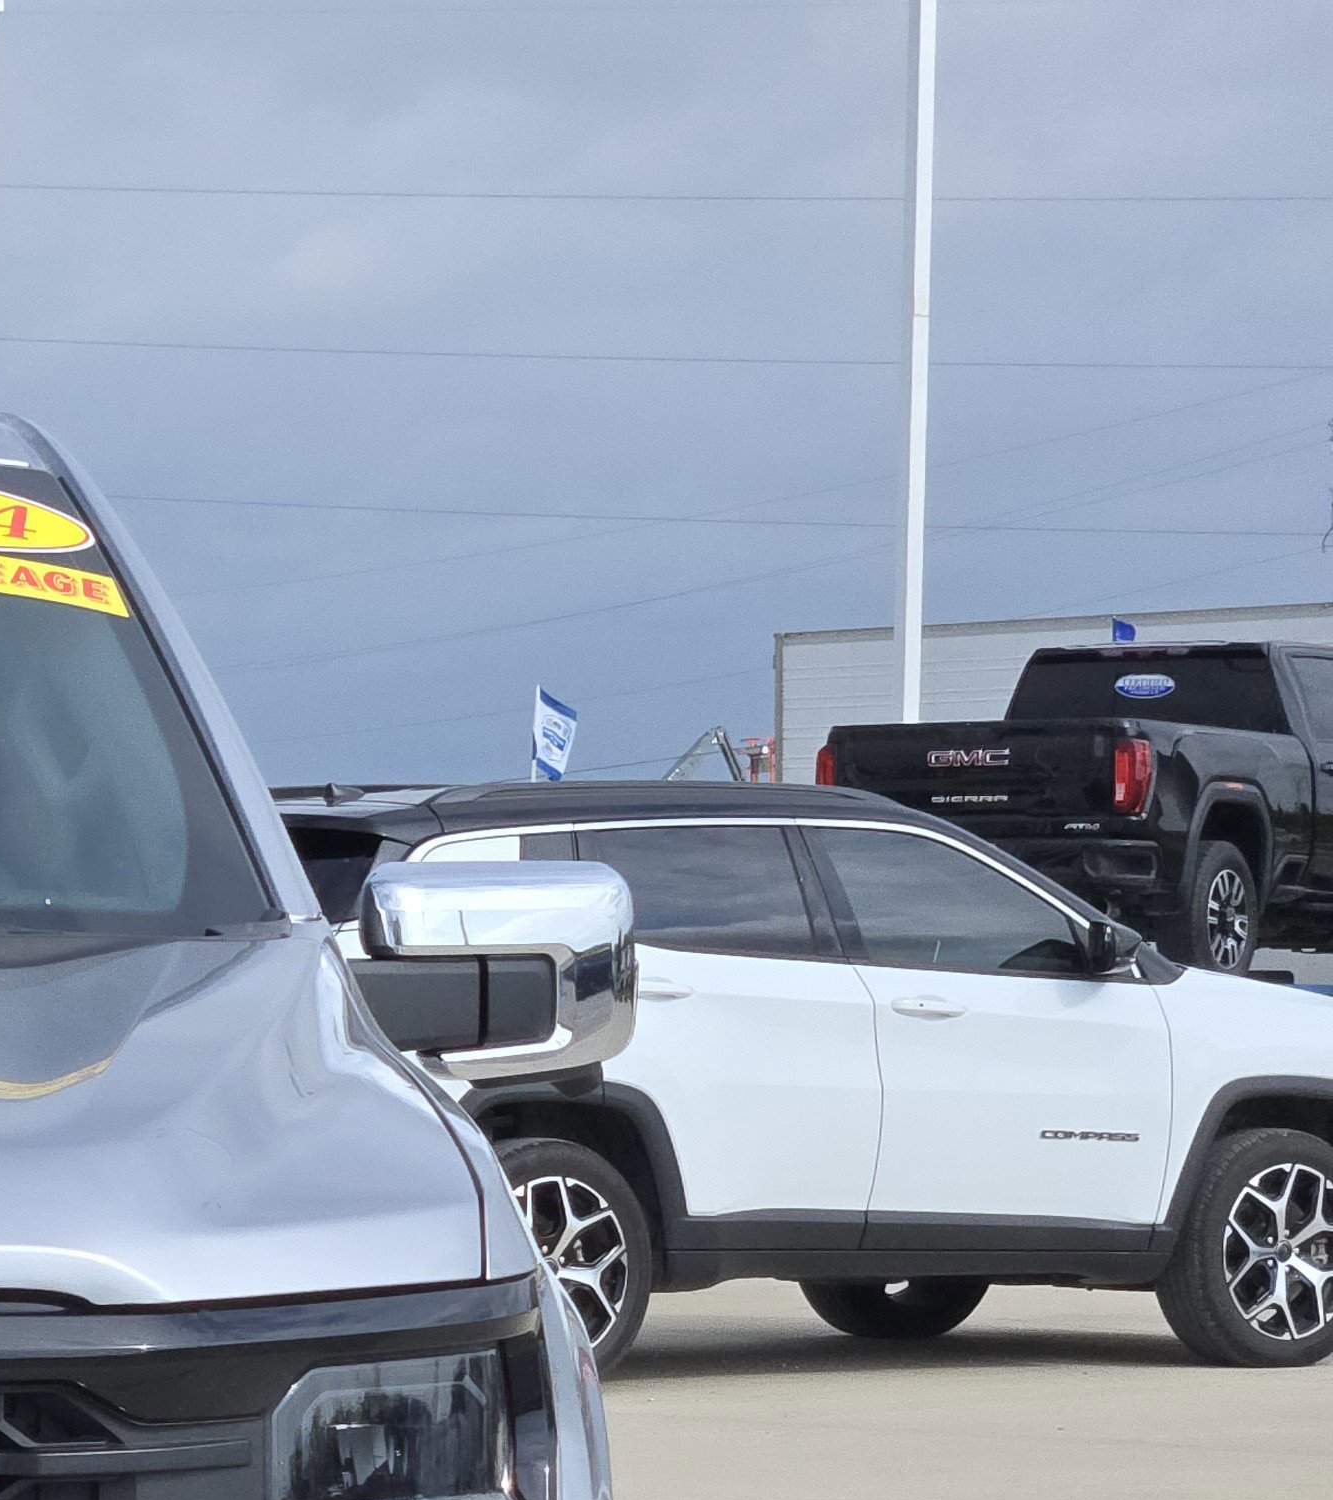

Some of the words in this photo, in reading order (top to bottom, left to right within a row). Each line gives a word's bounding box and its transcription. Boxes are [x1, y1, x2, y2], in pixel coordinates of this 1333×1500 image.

[927, 748, 1011, 767] GMC
[931, 795, 1009, 804] SIERRA
[1040, 1130, 1140, 1142] COMPASS
